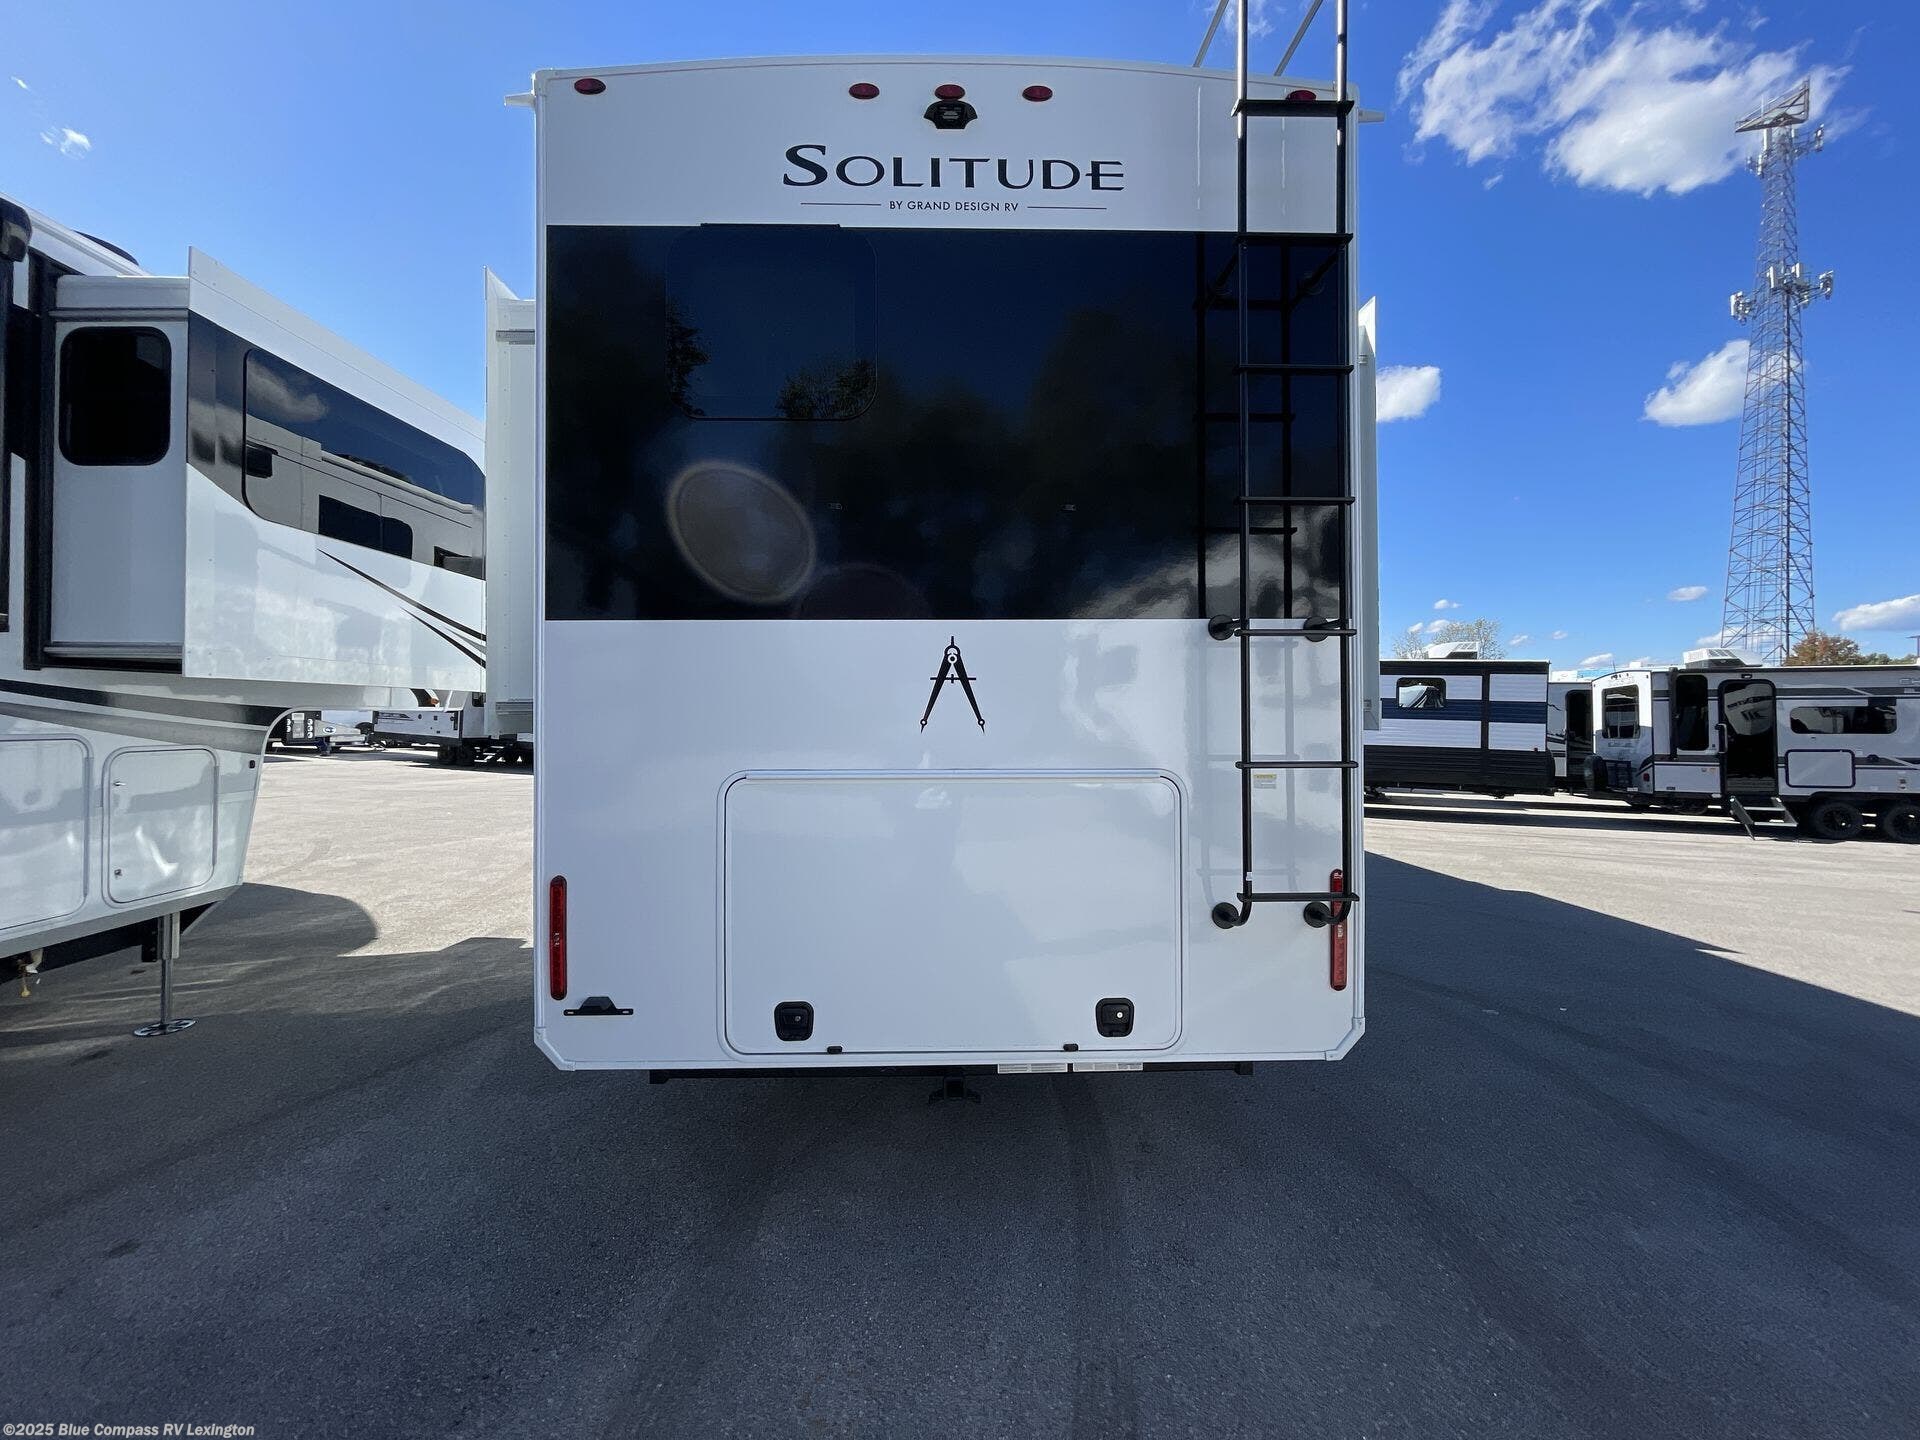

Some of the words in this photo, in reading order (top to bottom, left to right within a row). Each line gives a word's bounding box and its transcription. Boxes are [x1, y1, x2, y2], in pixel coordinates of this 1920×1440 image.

[783, 143, 1125, 191] SOLITUDE
[889, 200, 903, 210] BY
[907, 200, 951, 211] GRAND
[955, 201, 1000, 212] DESIGN
[1004, 202, 1019, 212] RV
